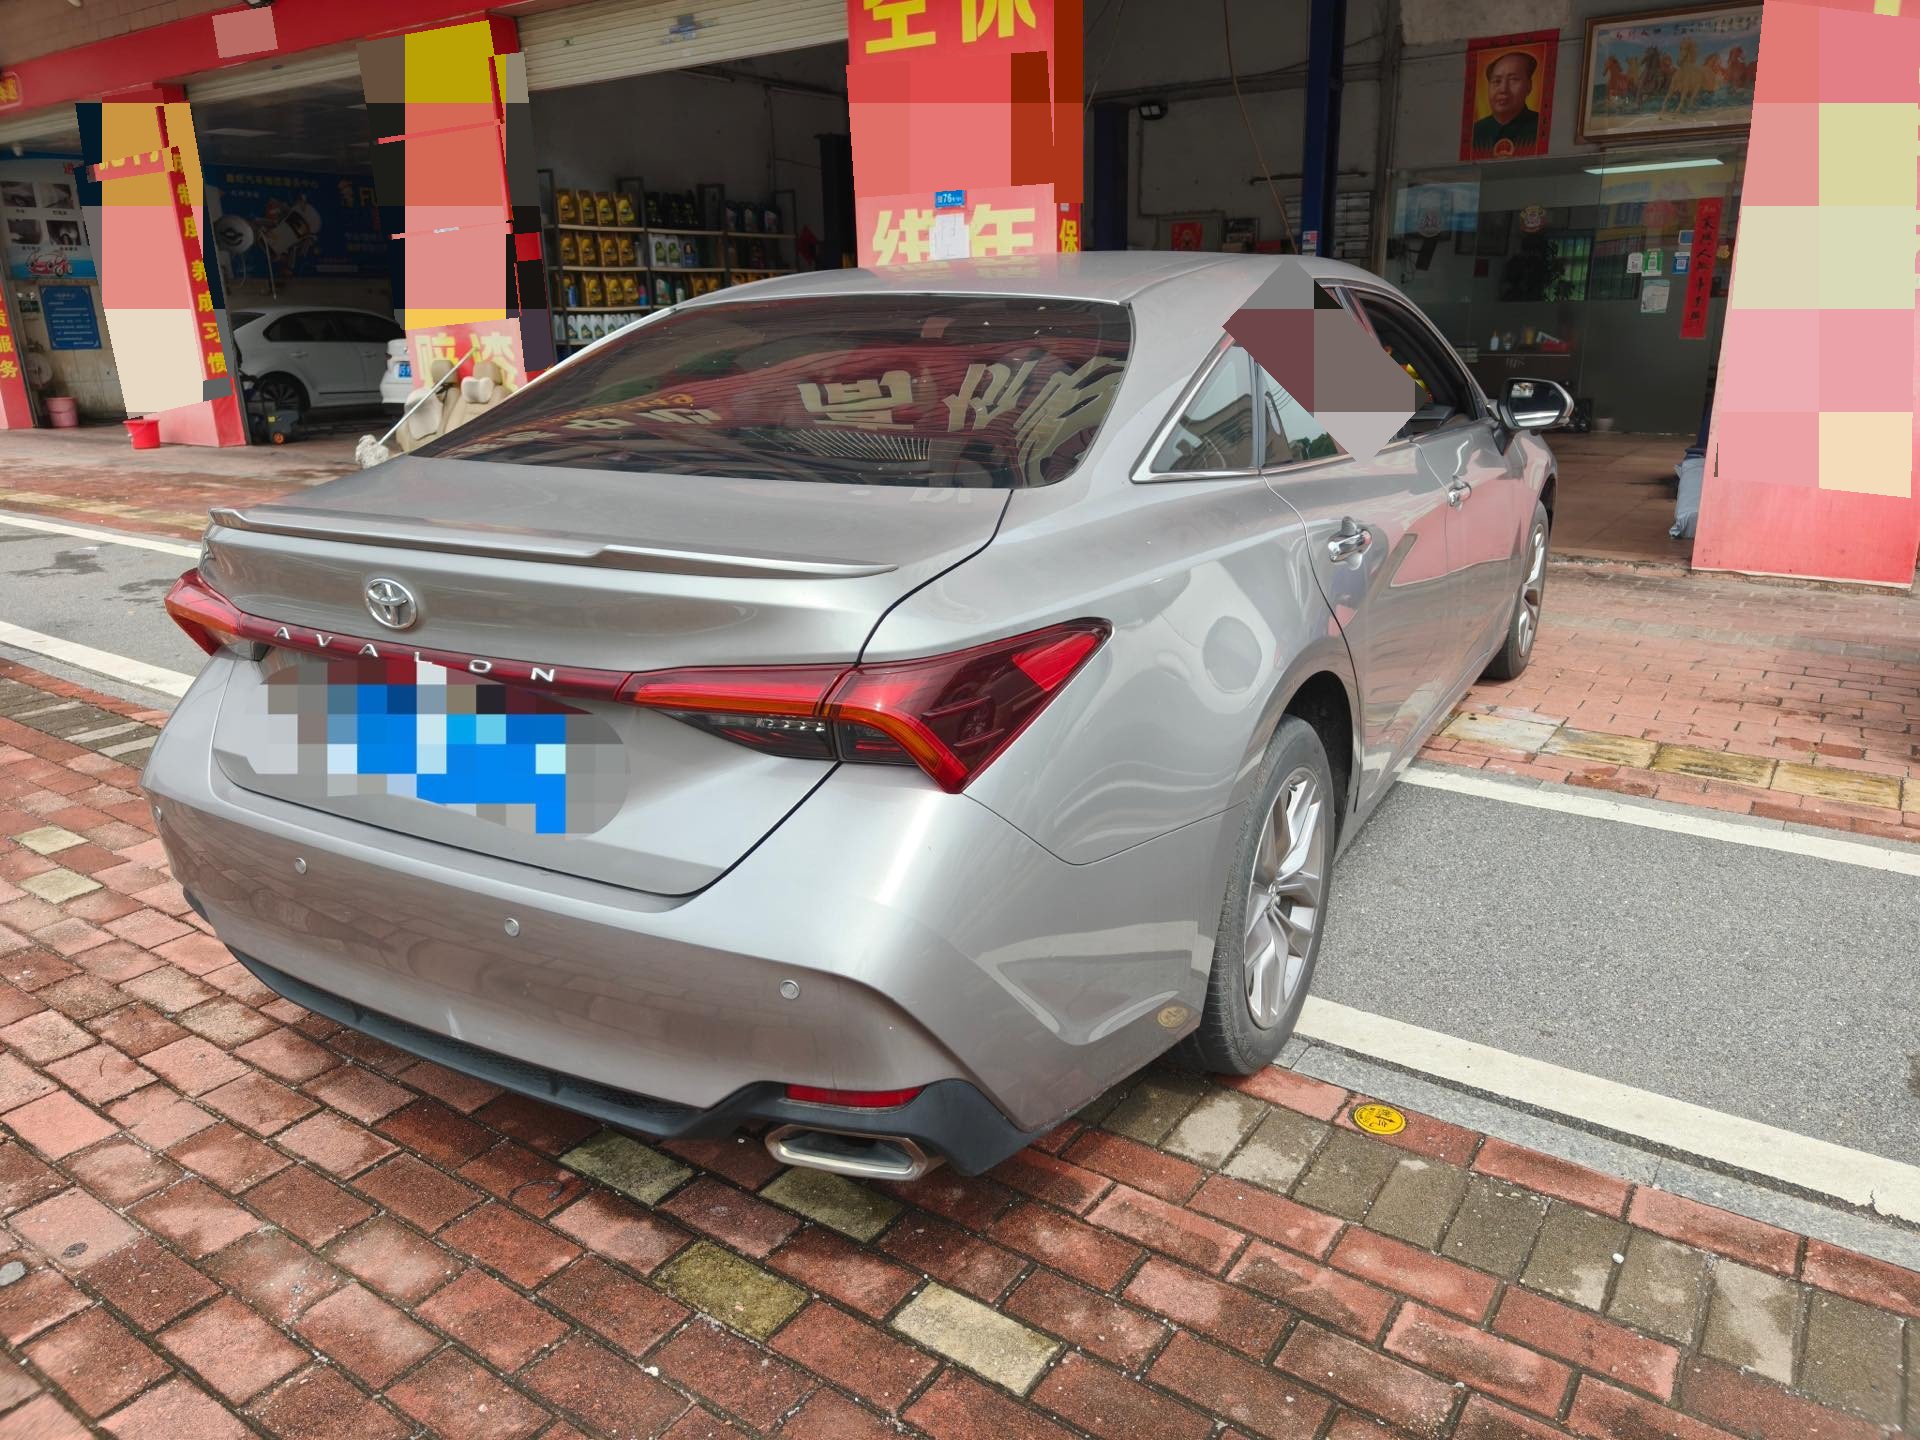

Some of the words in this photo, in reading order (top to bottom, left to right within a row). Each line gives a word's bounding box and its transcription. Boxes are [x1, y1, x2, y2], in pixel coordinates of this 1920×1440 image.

[191, 260, 228, 374] 养成习惯
[274, 626, 556, 683] AVALON
